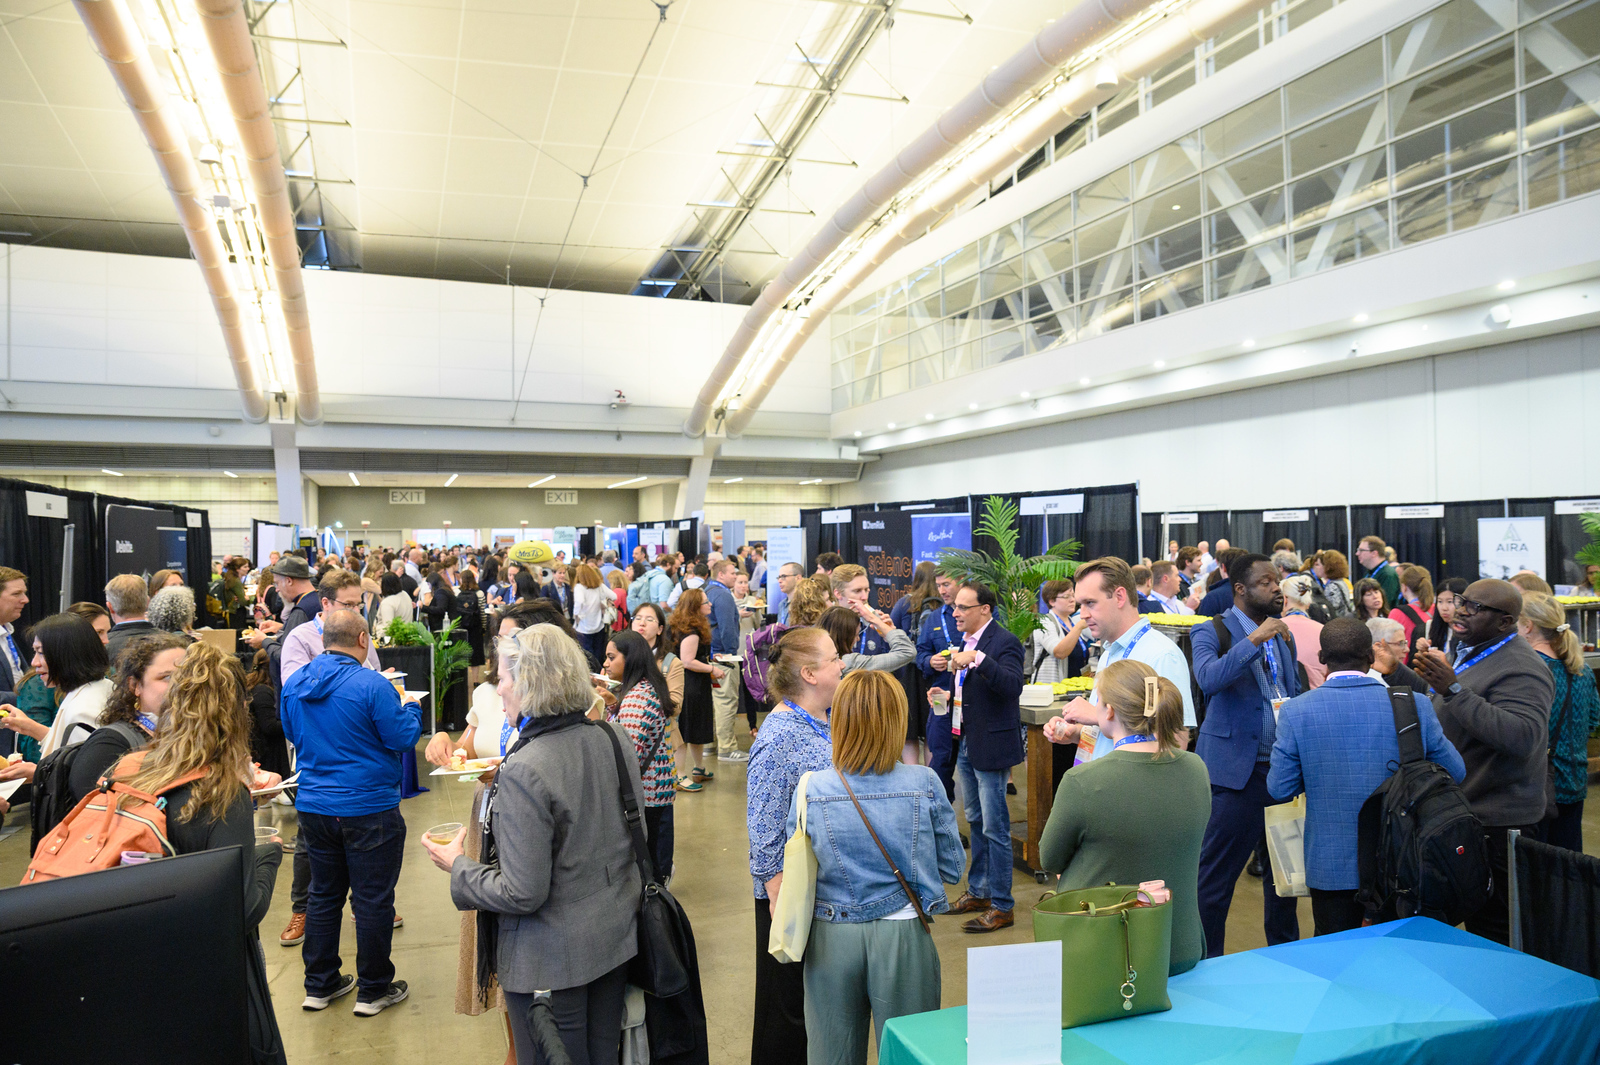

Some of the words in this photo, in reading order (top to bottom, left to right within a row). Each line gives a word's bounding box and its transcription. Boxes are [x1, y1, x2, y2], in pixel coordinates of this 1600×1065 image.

[391, 491, 423, 502] EXIT
[546, 492, 576, 502] EXIT
[1496, 543, 1528, 552] AIRA
